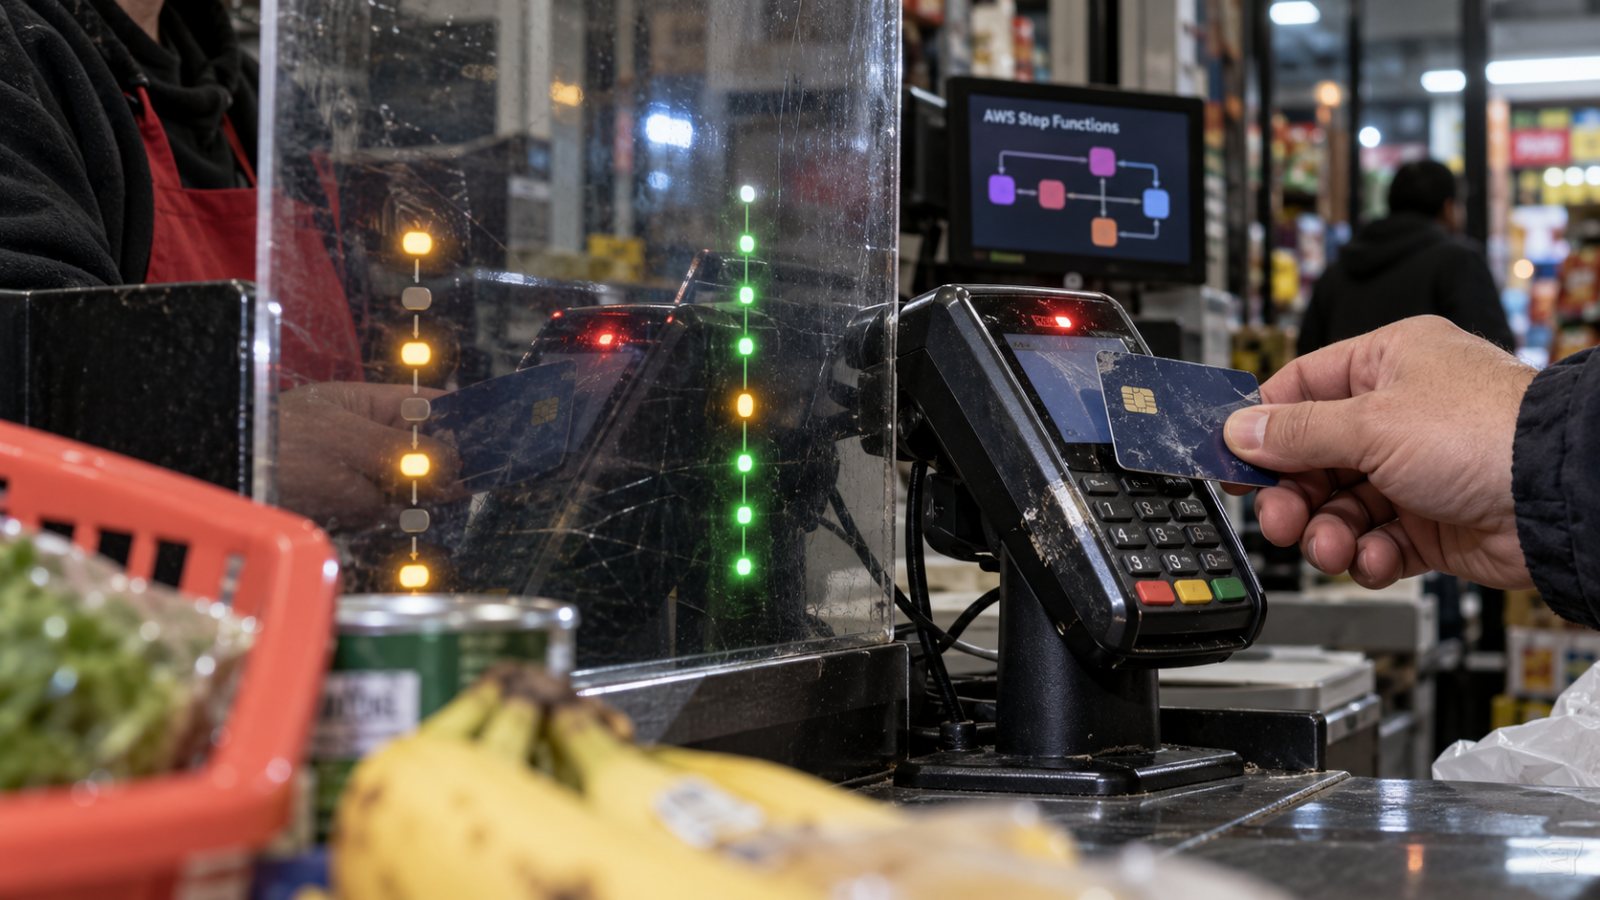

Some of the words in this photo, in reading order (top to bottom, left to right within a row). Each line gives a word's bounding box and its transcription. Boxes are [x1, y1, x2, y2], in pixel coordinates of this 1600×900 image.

[983, 108, 1016, 125] AWS
[1018, 111, 1050, 131] Step
[1052, 114, 1120, 134] Functions
[1118, 528, 1129, 542] 4
